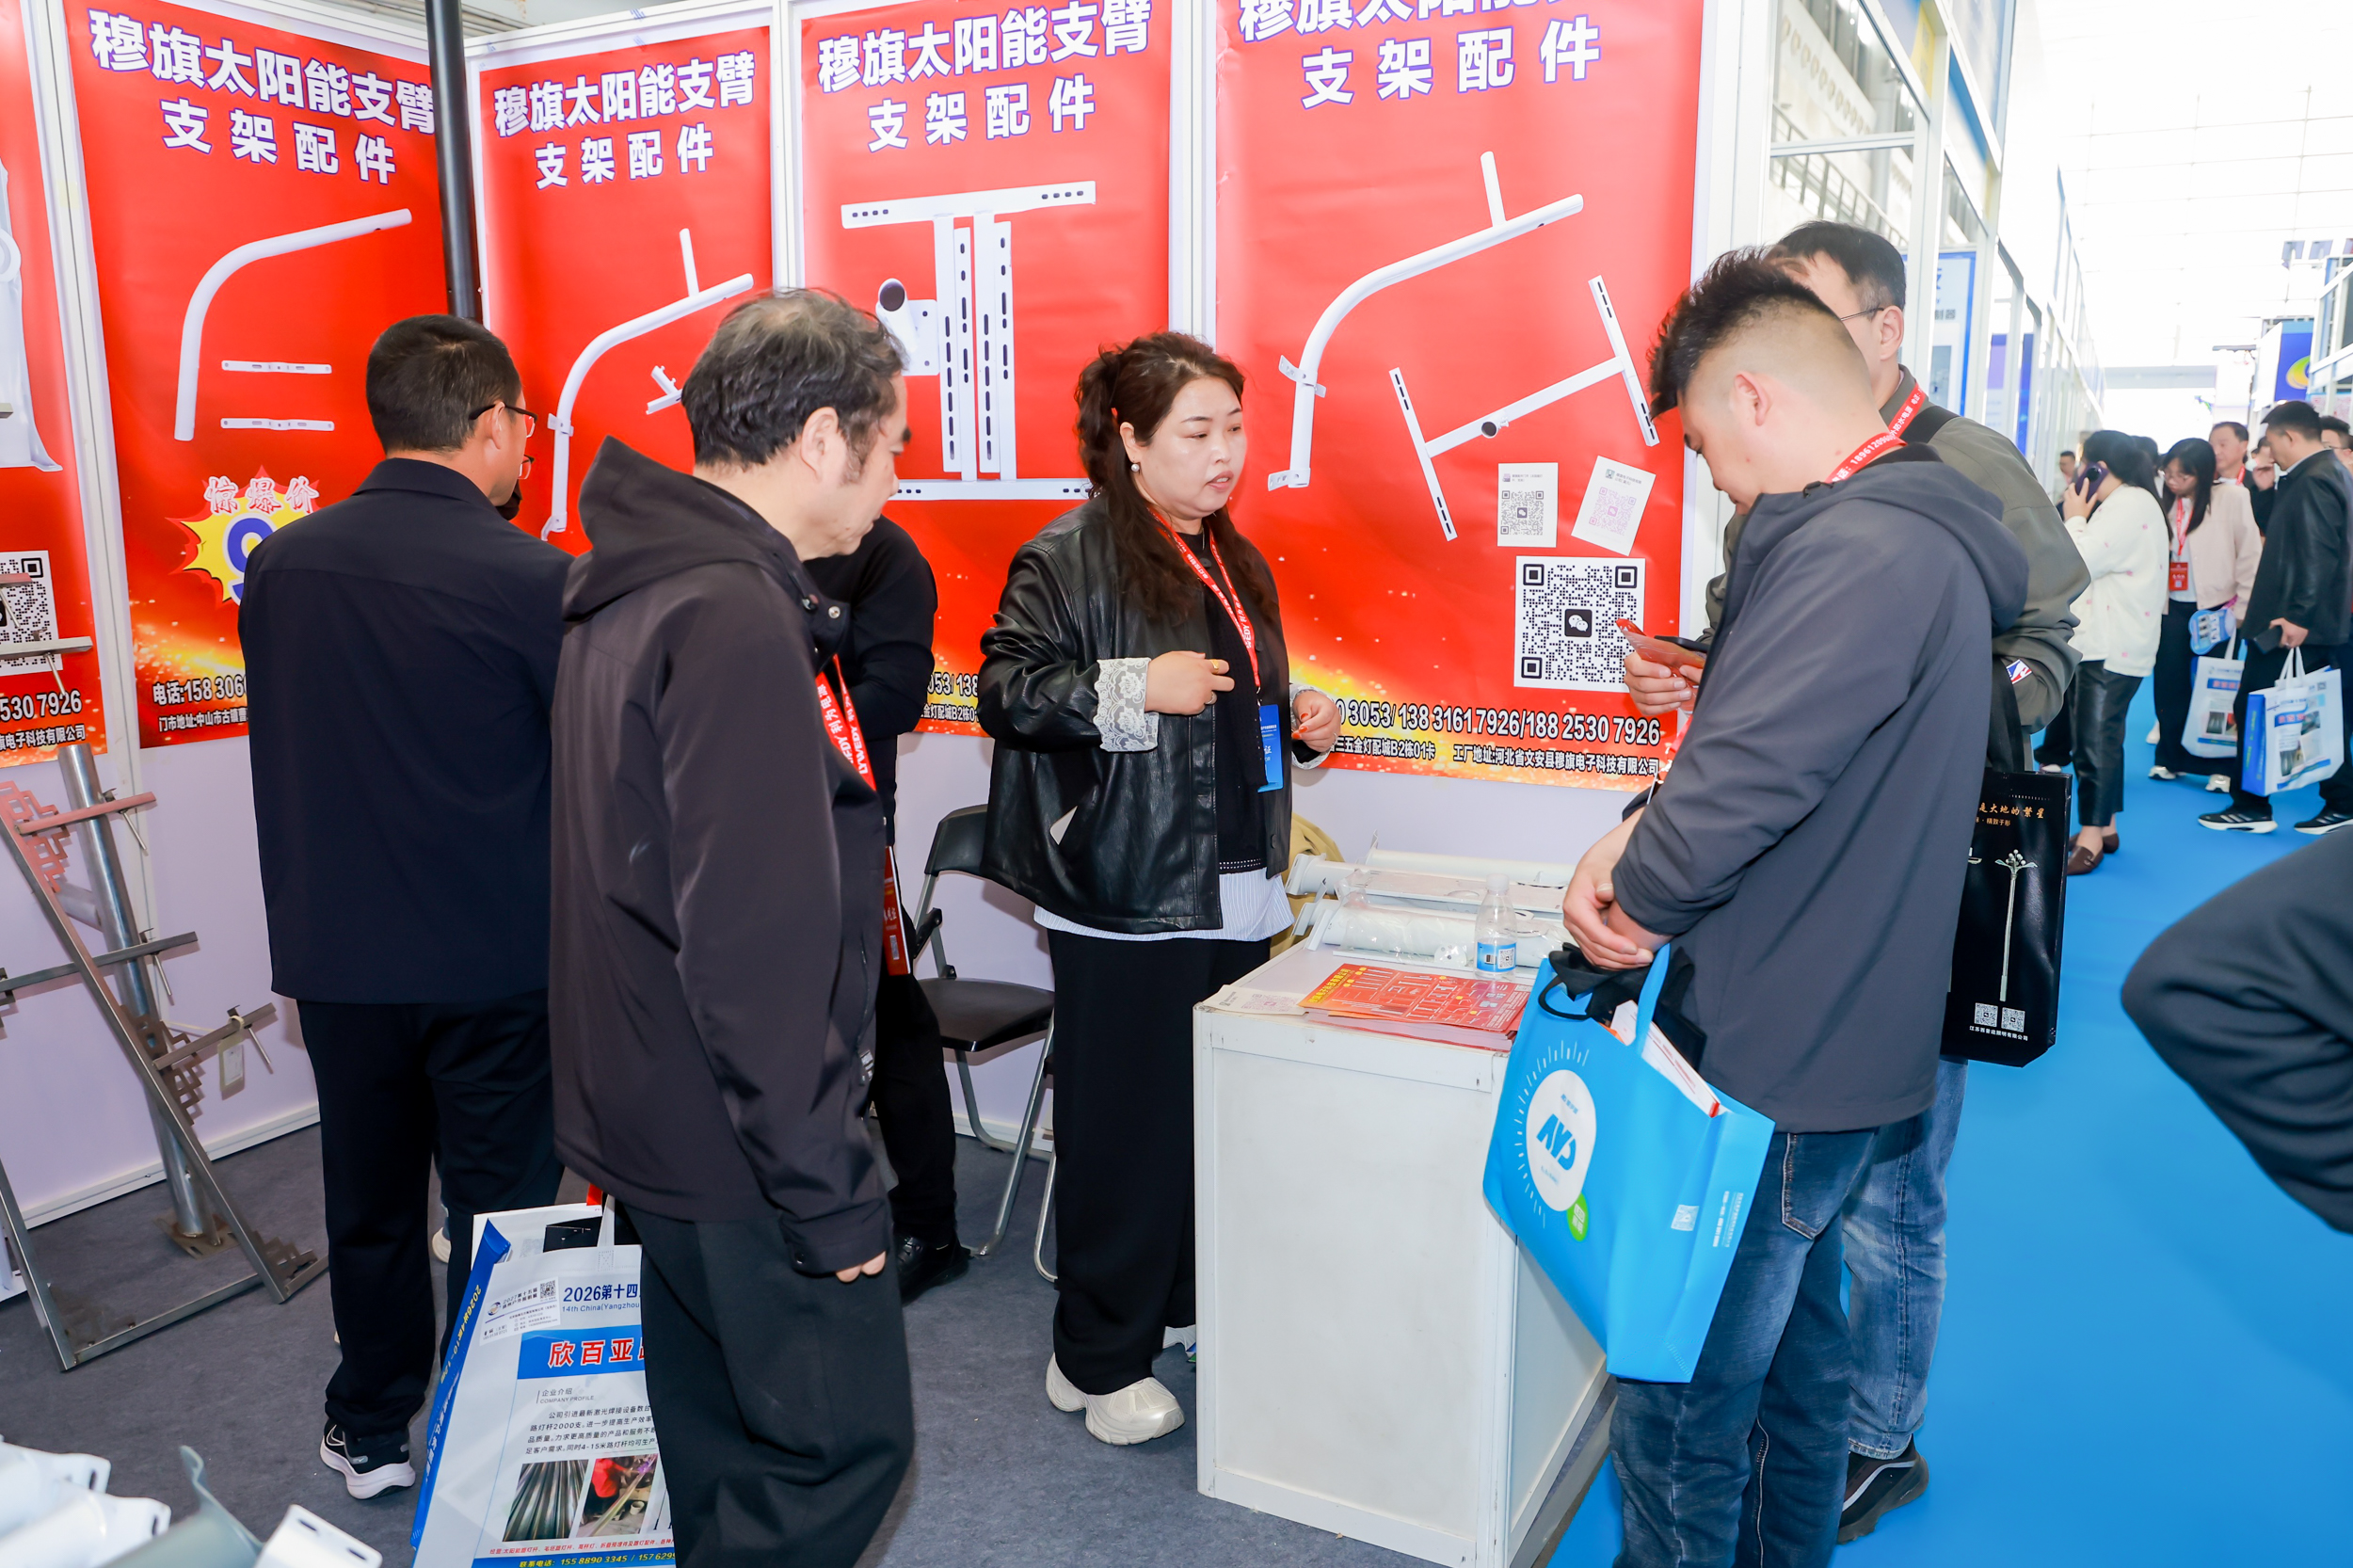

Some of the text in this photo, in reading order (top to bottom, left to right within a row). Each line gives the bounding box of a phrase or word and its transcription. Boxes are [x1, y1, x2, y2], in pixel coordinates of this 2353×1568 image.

[817, 0, 1151, 93] 穆旗太阳能支臂
[1300, 14, 1600, 110] 支架配件
[88, 8, 435, 135] 穆旗太阳能支臂
[494, 50, 755, 137] 穆旗太阳能支臂
[867, 73, 1096, 153] 支架配件
[160, 98, 396, 184] 支架配件
[535, 122, 713, 189] 支架配件
[203, 475, 320, 515] 惊爆价
[36, 688, 83, 718] 7926
[215, 674, 248, 699] 306
[817, 683, 843, 734] 利为电源
[157, 706, 248, 732] 门市地址:中山市古镇曹
[1399, 702, 1429, 730] 138
[1433, 704, 1472, 733] 3161
[1475, 707, 1559, 740] 7926/188
[1561, 712, 1609, 743] 2530
[1612, 715, 1661, 746] 7926
[850, 725, 869, 775] LYWEDY
[564, 1283, 641, 1303] 2026第十四
[548, 1336, 645, 1368] 欣百亚
[541, 1387, 573, 1398] 企业介绍
[561, 1558, 578, 1566] 155
[578, 1556, 602, 1565] 8890
[604, 1554, 628, 1563] 3345
[638, 1553, 655, 1561] 157
